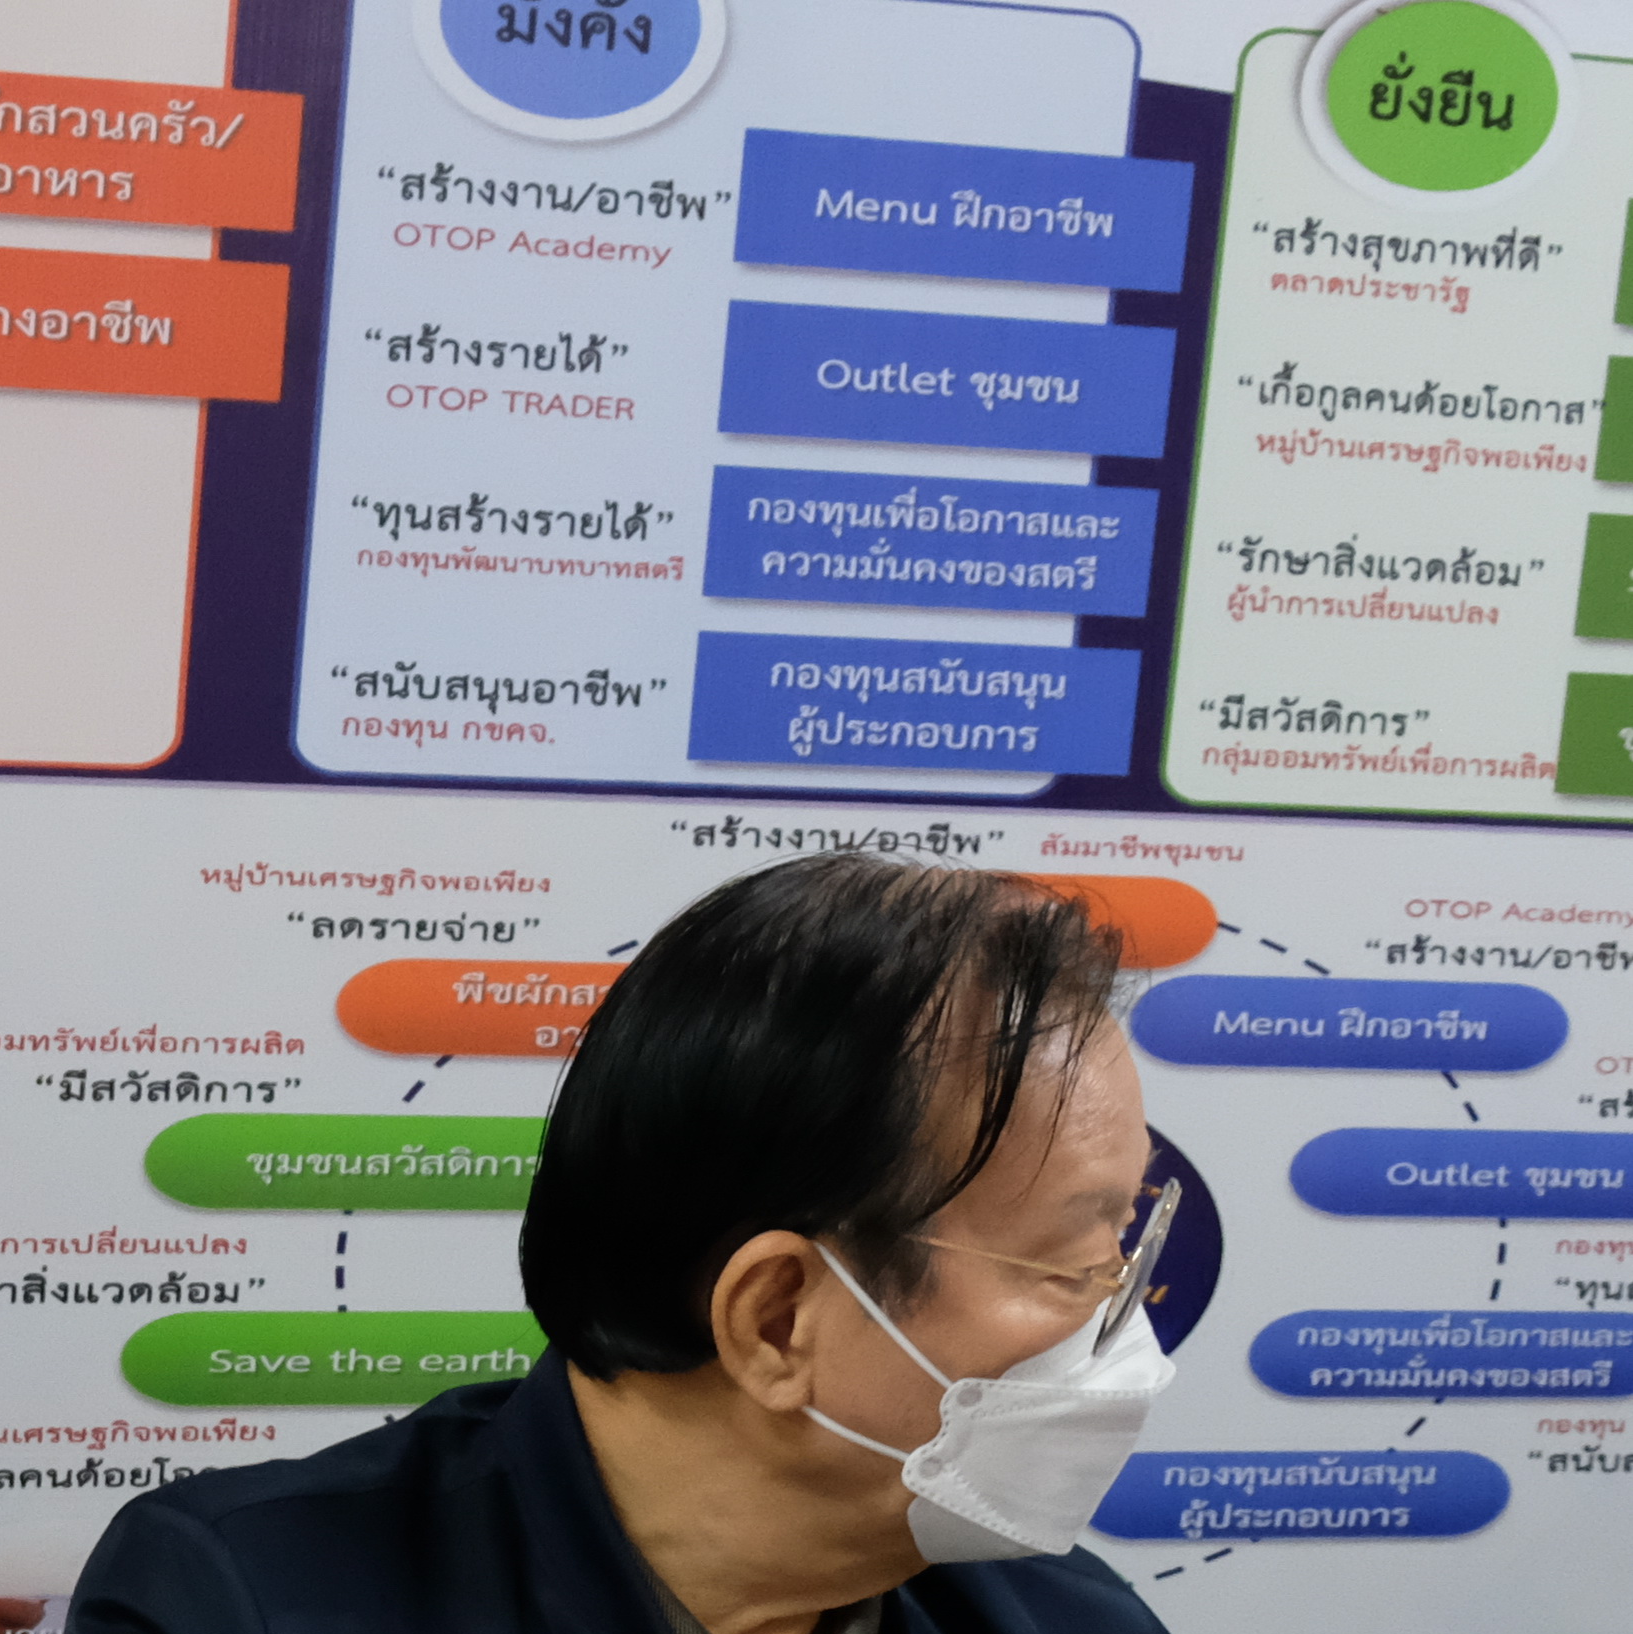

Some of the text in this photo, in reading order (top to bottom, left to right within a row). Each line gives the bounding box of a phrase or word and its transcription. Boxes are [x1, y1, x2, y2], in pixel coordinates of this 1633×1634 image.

[1369, 52, 1515, 131] ยั่งยืน
[377, 164, 731, 222] “สร้างงาน/อาชีพ”
[815, 188, 1115, 238] Menu ฝึกอาชีพ
[394, 223, 672, 269] OTOP Academy
[1253, 217, 1563, 273] “สร้างสุขภาพที่ดี”
[1270, 271, 1471, 313] ตลาดประชารัฐ
[364, 324, 629, 376] “สร้างรายได้”
[386, 384, 635, 421] OTOP TRADER
[816, 358, 1081, 411] Outlet ชุมชน
[1256, 430, 1588, 474] หมู่บ้านเศรษฐกิจพอเพียง
[351, 493, 674, 542] “ทุนสร้างรายได้”
[748, 488, 1120, 540] กองทุนเพื่อโอกาสและ
[357, 545, 685, 581] กองทุนพัฒนาบทบาทสตรี
[762, 540, 1097, 591] ความมั่นคงของสตรี
[1217, 534, 1545, 588] “รักษาสิ่งแวดล้อม”
[1227, 584, 1500, 624] ผู้นำการเปลี่ยนแปลง
[331, 661, 667, 714] “สนับสนุนอาชีพ”
[770, 656, 1067, 708] กองทุนสนับสนุน
[341, 714, 556, 748] กองทุน กขคจ.
[788, 706, 1038, 757] ผู้ประกอบการ
[1199, 695, 1429, 738] “มีสวัสดิการ”
[1040, 833, 1245, 866] สัมมาชีพชุมชน
[200, 862, 551, 897] หมู่บ้านเศรษฐกิจพอเพียง
[286, 911, 541, 944] “ลดรายจ่าย”
[1405, 898, 1493, 920] OTOP
[1213, 1008, 1489, 1042] Menu ฝึกอาชีพ
[36, 1070, 301, 1105] “มีสวัสดิการ”
[1386, 1161, 1626, 1197] Outlet ชุมชน
[209, 1347, 532, 1376] Save the earth
[1309, 1352, 1613, 1389] ความมั่นคงของสตรี
[1163, 1456, 1436, 1493] กองทุนสนับสนุน
[1179, 1499, 1411, 1537] ผู้ประกอบการ
